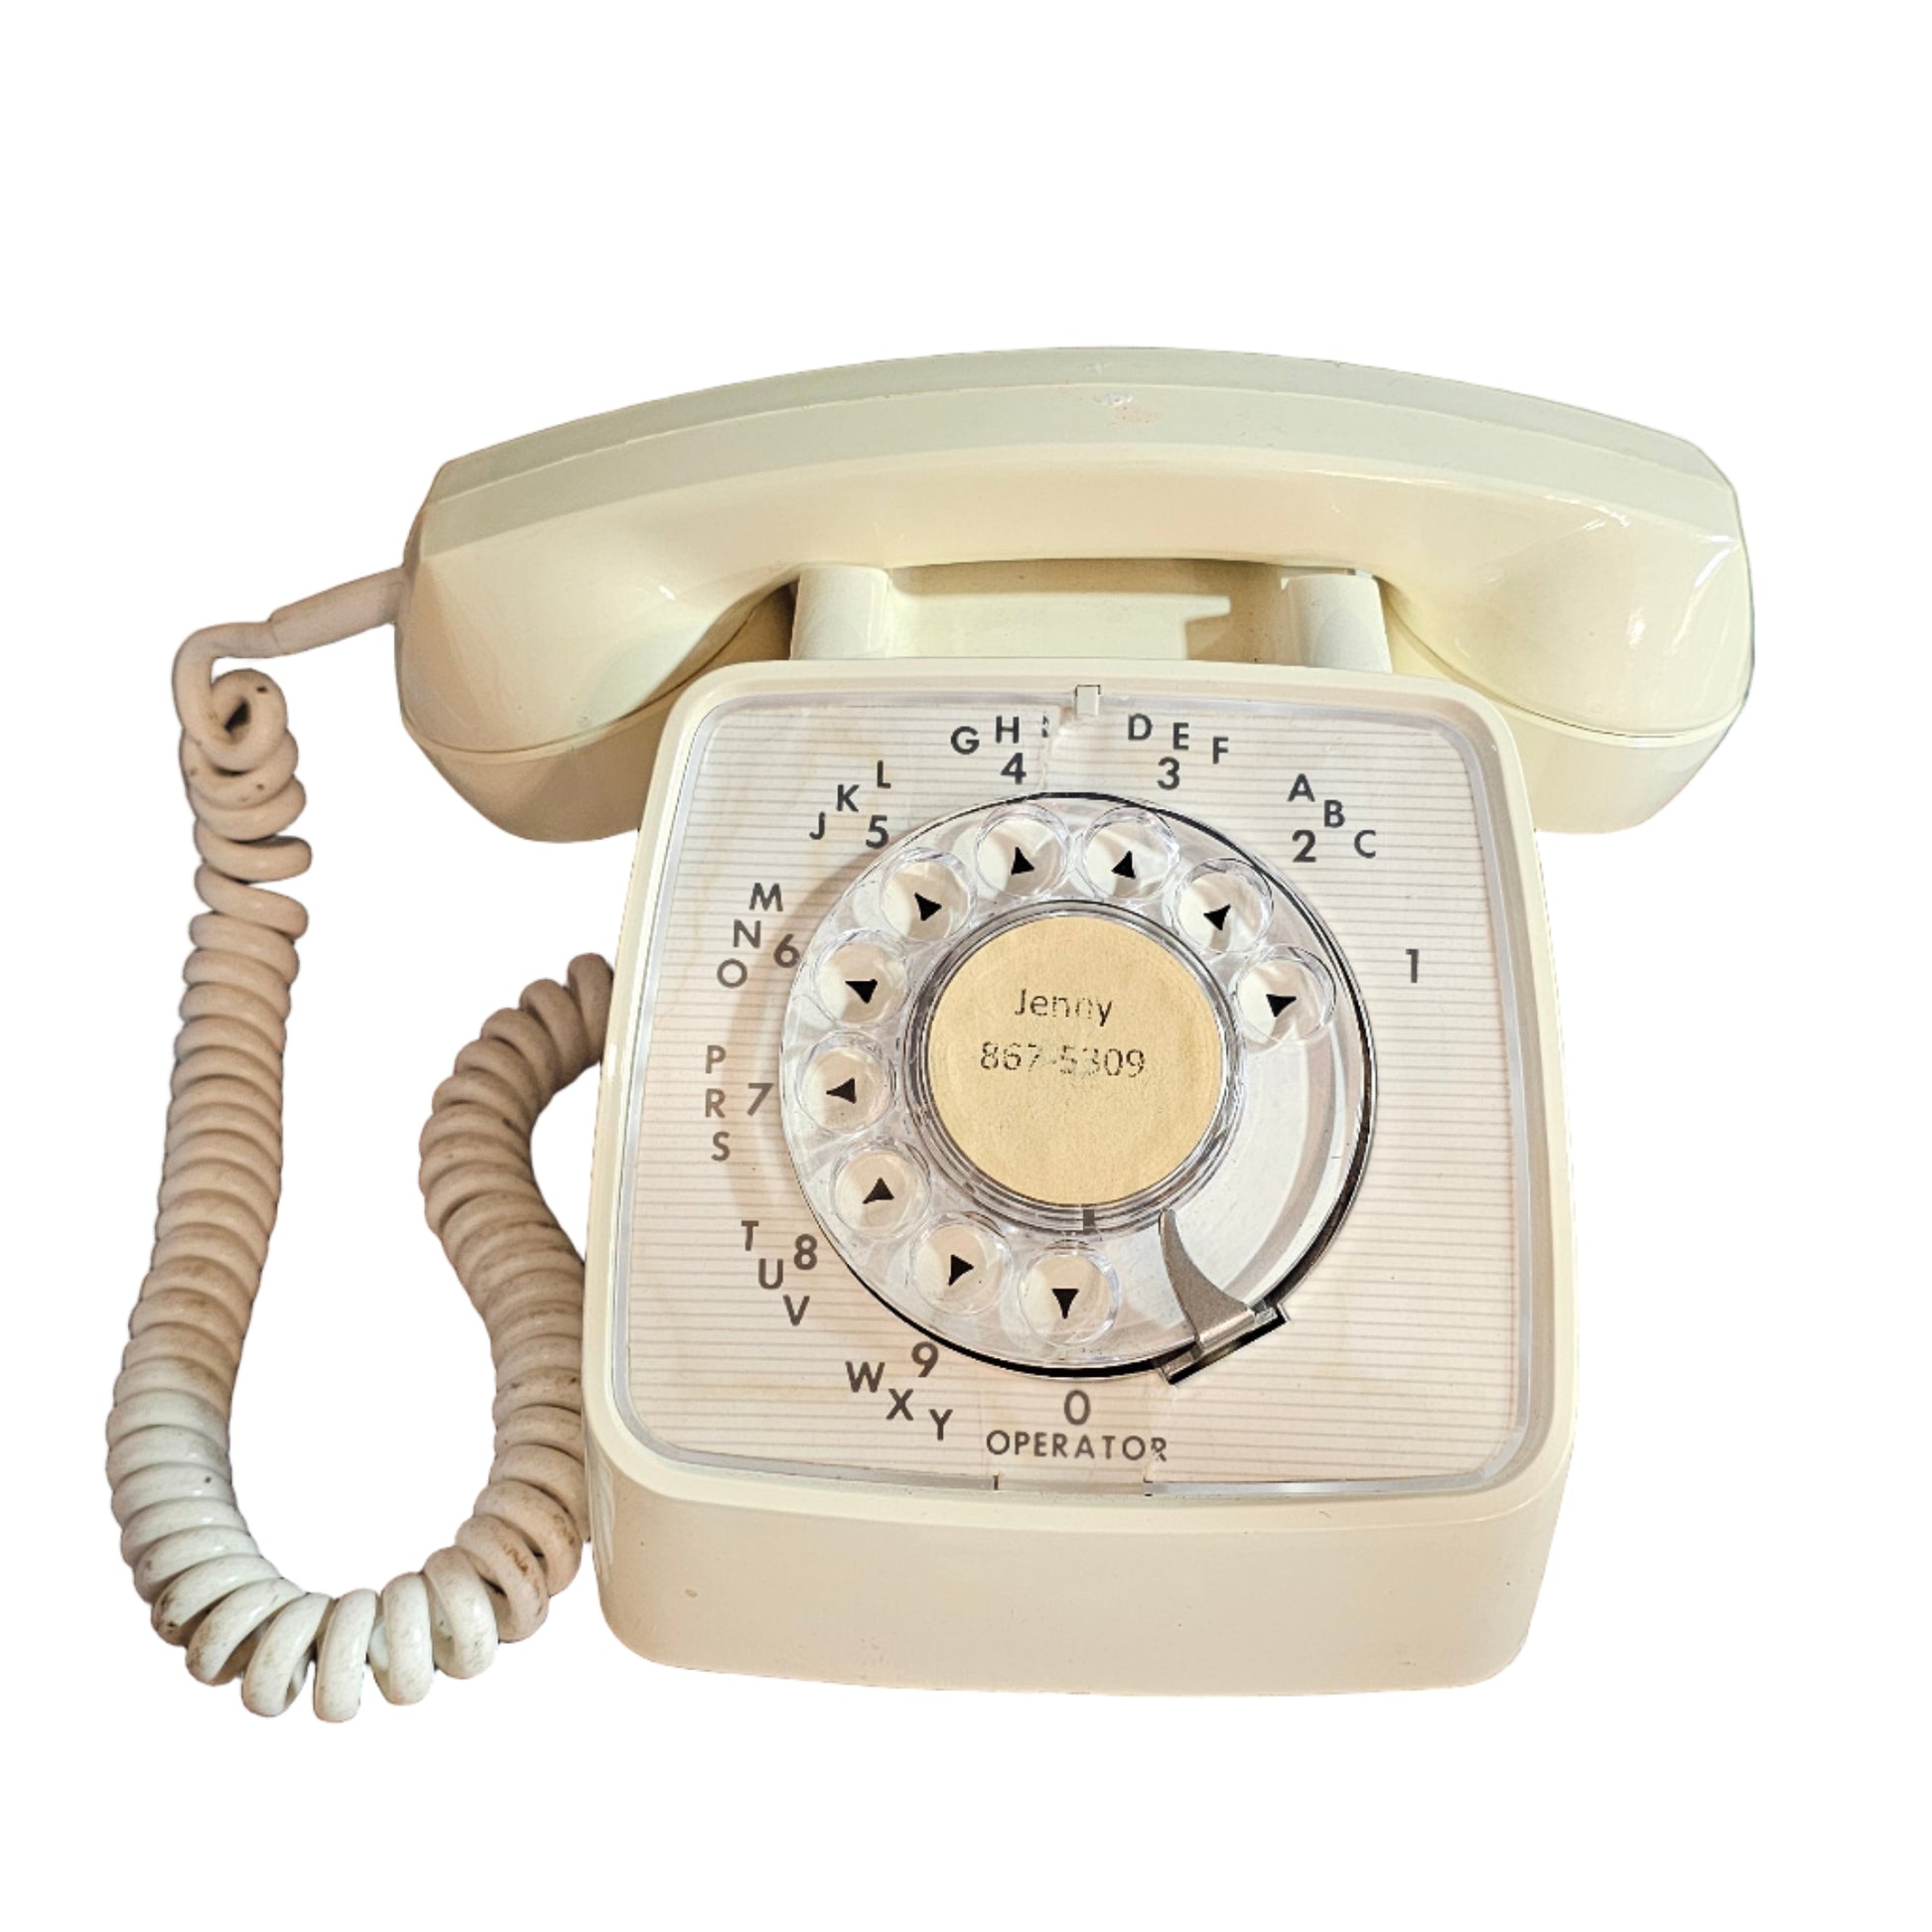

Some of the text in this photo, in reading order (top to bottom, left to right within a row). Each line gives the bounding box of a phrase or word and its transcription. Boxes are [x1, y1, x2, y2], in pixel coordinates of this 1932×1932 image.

[950, 726, 980, 756] G
[995, 715, 1020, 745] H
[1127, 713, 1229, 765] D E F
[1000, 752, 1028, 785] 4
[1157, 756, 1180, 791] 3
[808, 759, 892, 841] J K L
[1287, 772, 1377, 860] A B C
[865, 814, 890, 851] 5
[1292, 829, 1316, 863] 2
[716, 882, 784, 989] M N O
[772, 933, 801, 969] 6
[1405, 948, 1420, 984] 1
[1014, 988, 1113, 1028] Jenny
[705, 1044, 732, 1163] P R S
[747, 1082, 775, 1117] 7
[793, 1233, 818, 1271] 8
[741, 1219, 810, 1326] T U V
[910, 1340, 939, 1378] 9
[845, 1360, 954, 1442] W X Y
[1063, 1389, 1091, 1427] 0
[986, 1429, 1168, 1462] OPERATOR
